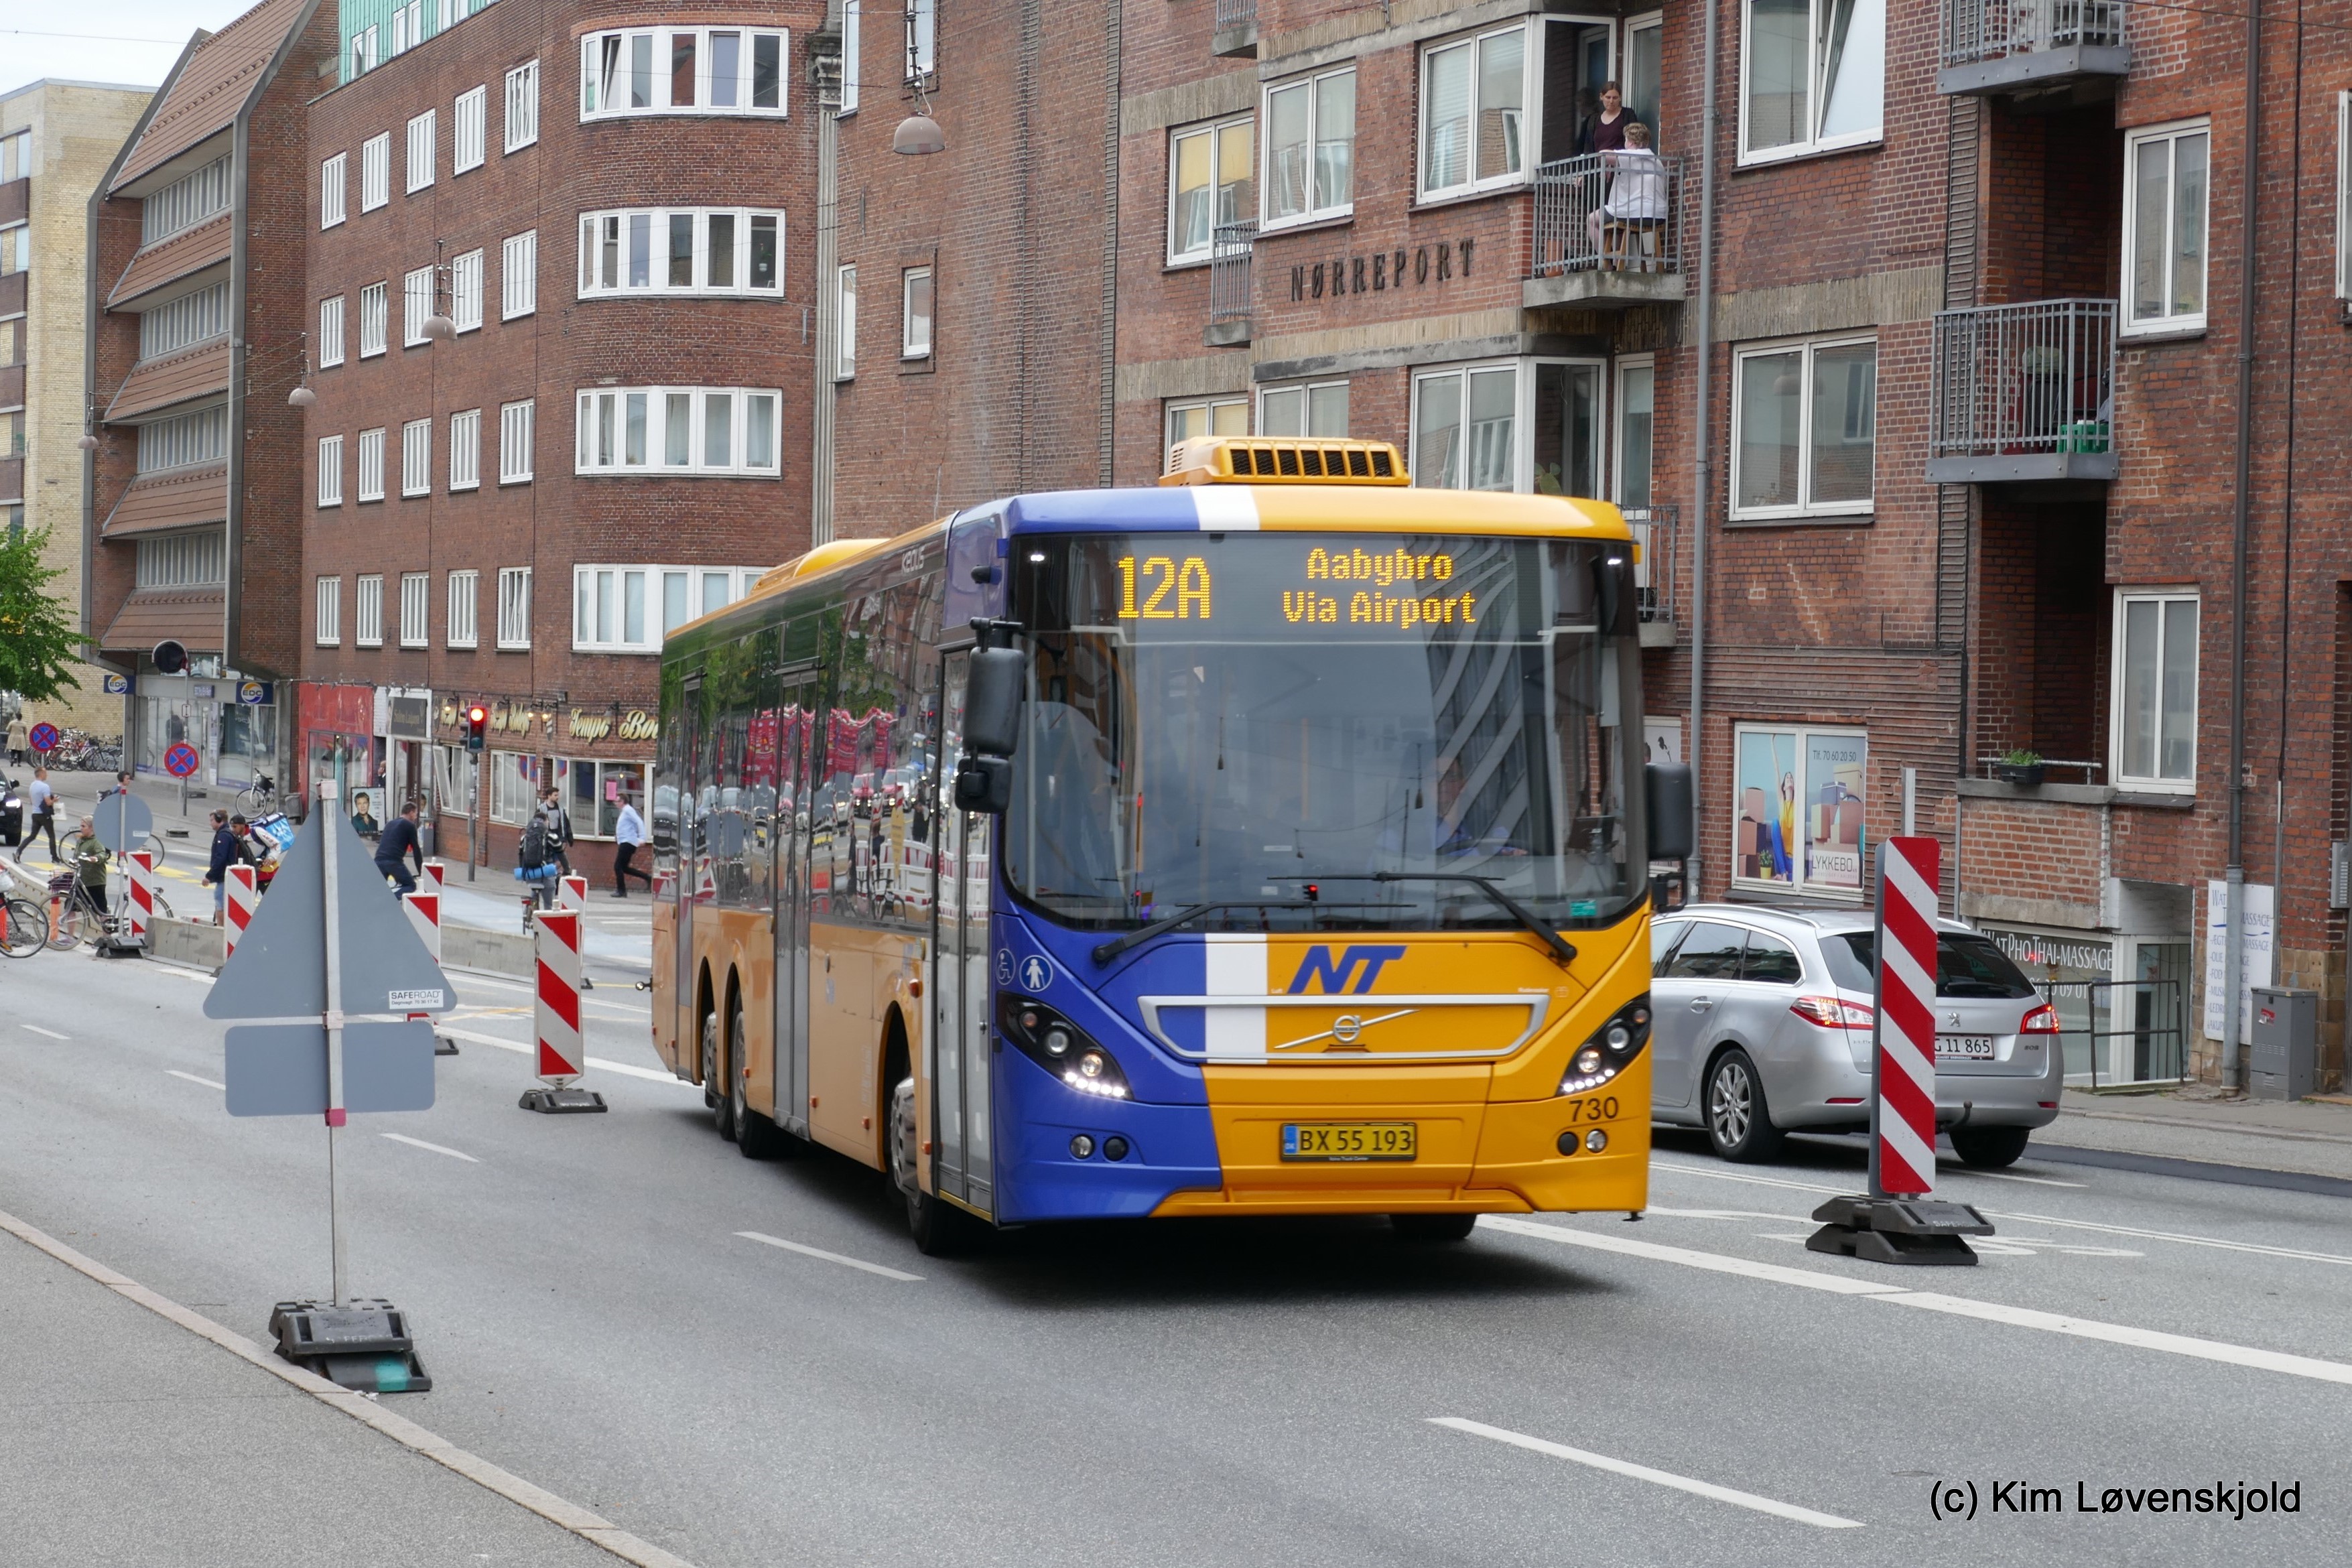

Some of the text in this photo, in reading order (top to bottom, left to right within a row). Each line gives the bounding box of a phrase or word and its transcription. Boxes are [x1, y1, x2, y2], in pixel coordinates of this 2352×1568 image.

[1291, 239, 1474, 302] NØRREPORT
[1307, 547, 1453, 586] Aabybro
[1118, 556, 1211, 619] 12A
[1283, 591, 1476, 629] Via Airport
[570, 708, 609, 743] Tempo
[1813, 750, 1856, 761] Tlf. 70 60 20 50
[1811, 855, 1853, 872] LYKKEBO
[1287, 945, 1407, 994] NT
[2008, 933, 2032, 962] PHO
[2032, 936, 2112, 972] THAI-MASSAGE
[391, 991, 439, 999] SAFEROAD
[1946, 1039, 1960, 1053] 11
[1965, 1039, 1990, 1053] 865
[1569, 1096, 1619, 1122] 730
[1300, 1130, 1330, 1151] BX
[1337, 1130, 1363, 1151] 55
[1372, 1130, 1412, 1151] 193
